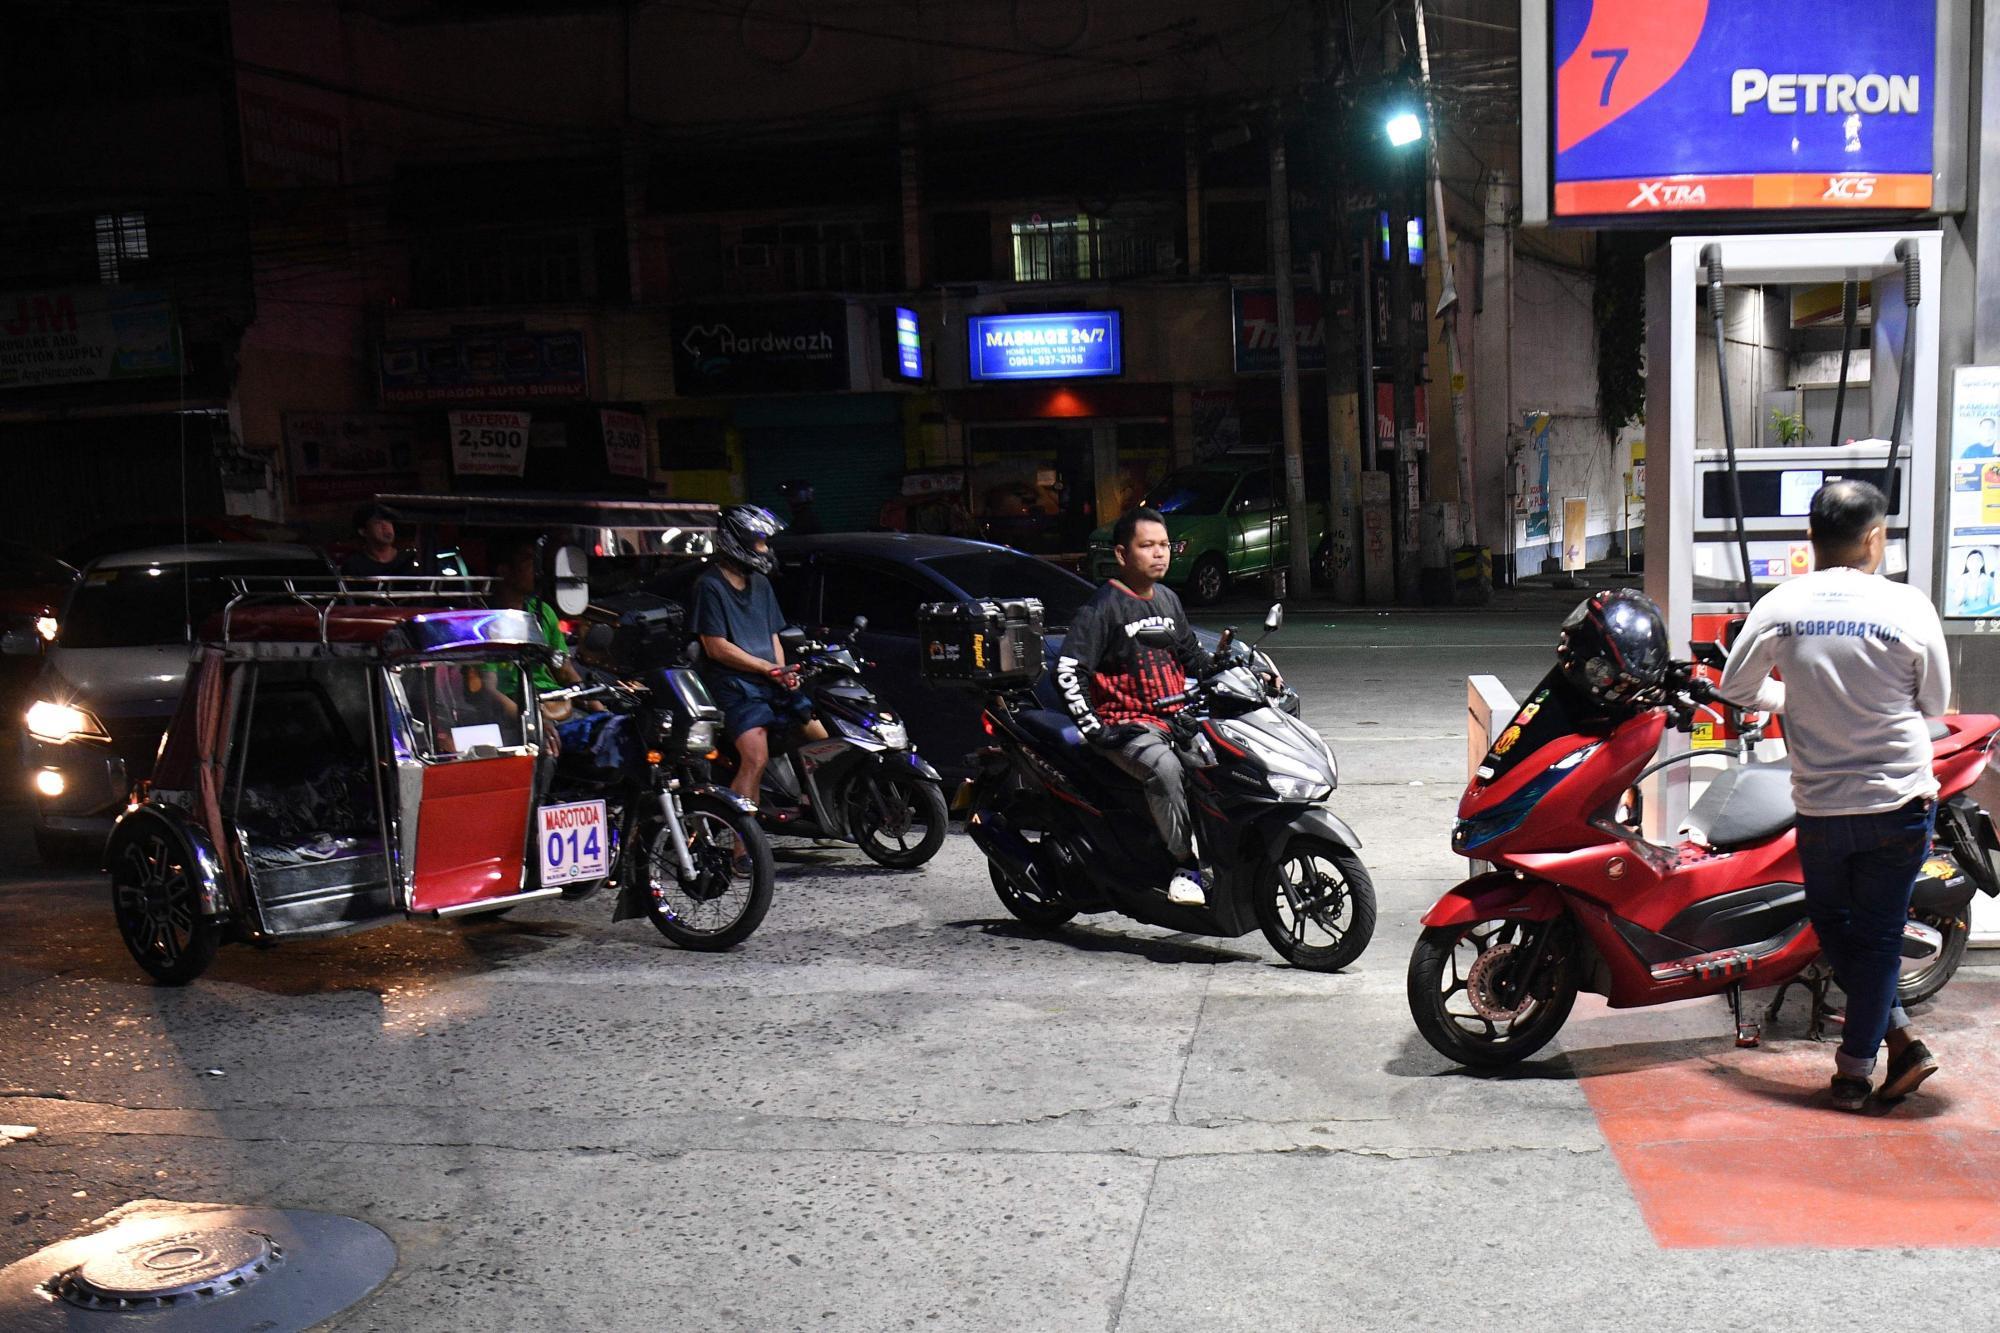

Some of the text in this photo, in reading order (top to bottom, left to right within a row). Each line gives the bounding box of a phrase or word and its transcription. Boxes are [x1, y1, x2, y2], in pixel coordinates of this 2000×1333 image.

[1591, 48, 1629, 106] 7
[1731, 68, 1920, 115] PETRON
[1822, 177, 1878, 201] XCS
[720, 330, 833, 353] Hardwazh
[986, 328, 1105, 347] MASSAGE 24/7
[489, 384, 525, 397] AUTO
[459, 413, 520, 425] BATERYA
[459, 429, 522, 449] 2,500
[606, 430, 641, 449] 2,500
[1057, 656, 1101, 734] MOVE IT
[545, 806, 600, 831] MAROTODA
[548, 826, 601, 867] 014
